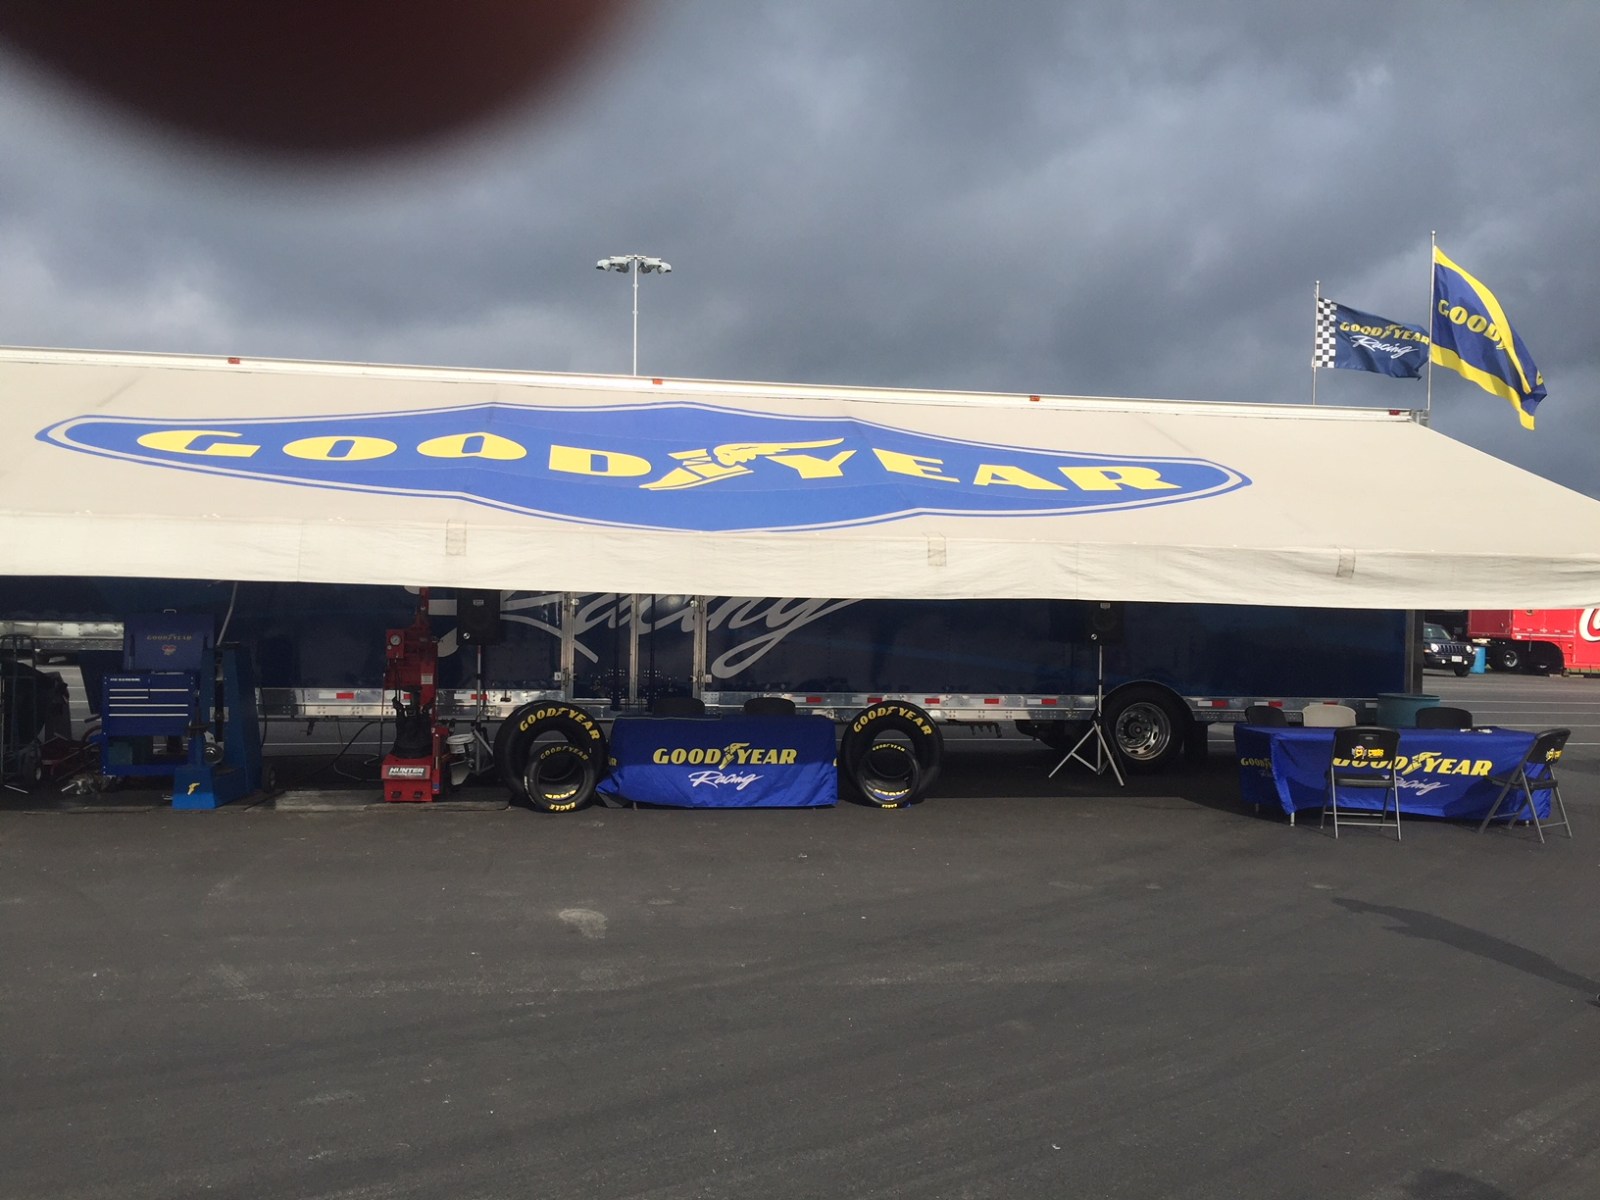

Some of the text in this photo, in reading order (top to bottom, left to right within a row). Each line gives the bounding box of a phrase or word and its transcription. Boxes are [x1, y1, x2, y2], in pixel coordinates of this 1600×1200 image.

[1340, 322, 1430, 345] GOODYEAR
[1350, 335, 1419, 359] Racing
[136, 429, 1181, 492] GOODYEAR
[519, 707, 601, 740] GOODYEAR
[853, 706, 933, 735] GOODYEAR
[540, 745, 589, 760] GOODYEAR
[652, 747, 798, 765] GOODYEAR
[688, 770, 764, 791] Racing
[1382, 774, 1450, 796] acing
[549, 802, 576, 812] EAGLE
